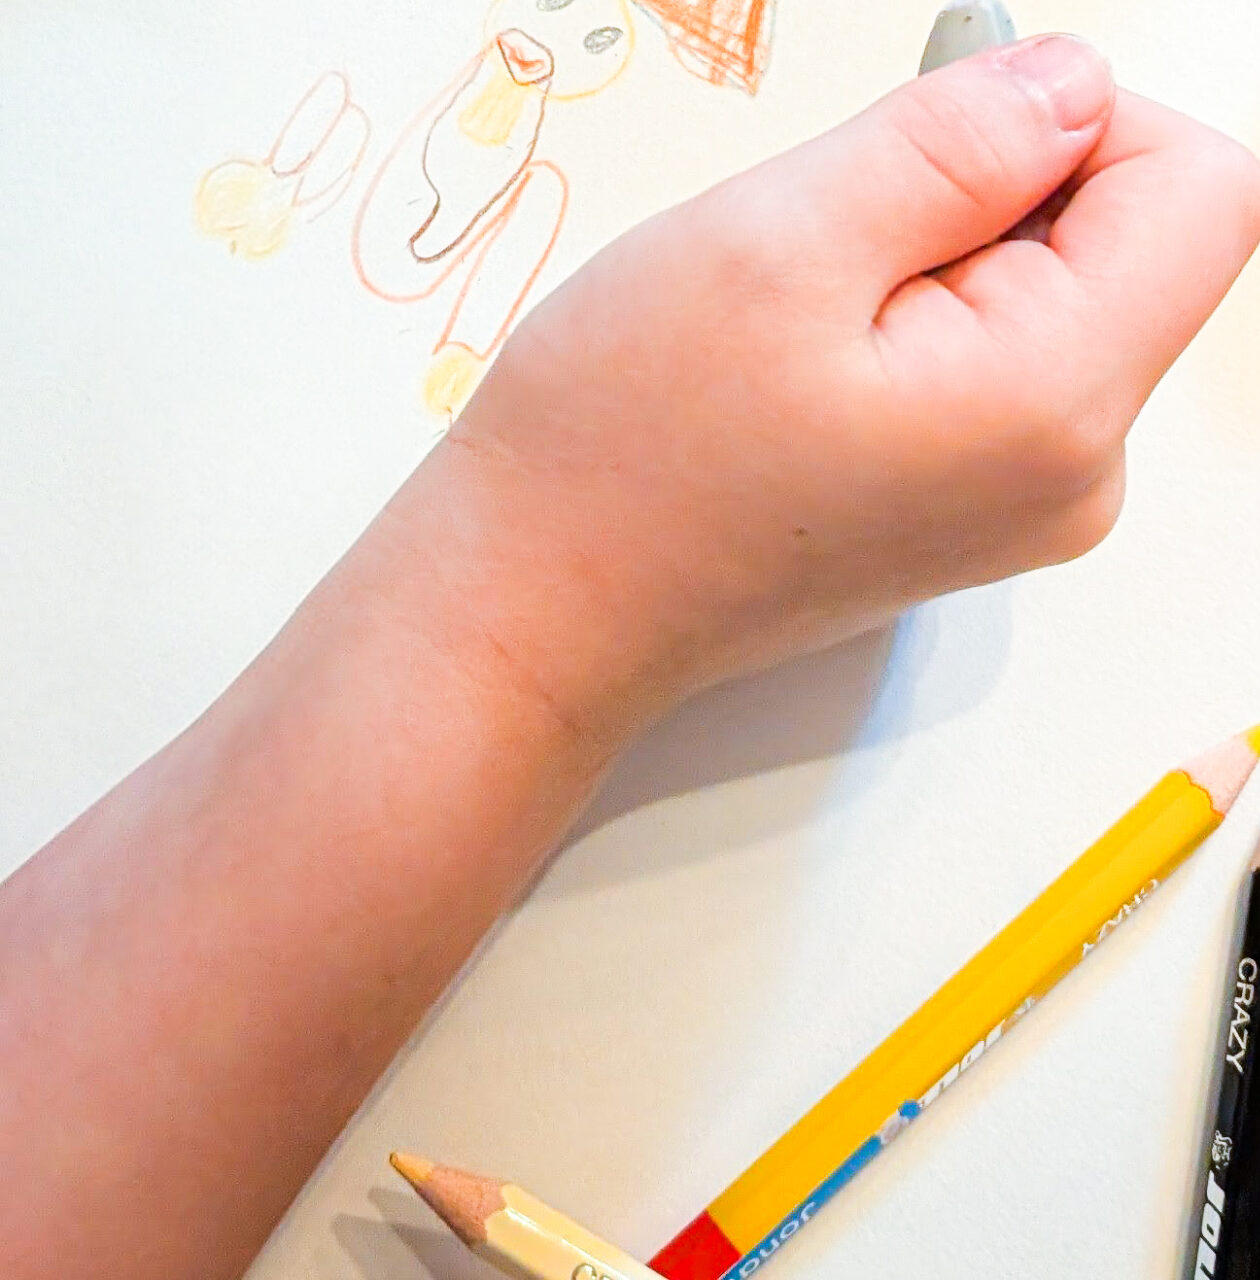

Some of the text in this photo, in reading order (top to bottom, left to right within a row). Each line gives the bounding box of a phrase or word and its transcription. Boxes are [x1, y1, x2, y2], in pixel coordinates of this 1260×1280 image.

[1193, 956, 1258, 1280] CRAZY JOL
[728, 1201, 816, 1280] Jona
